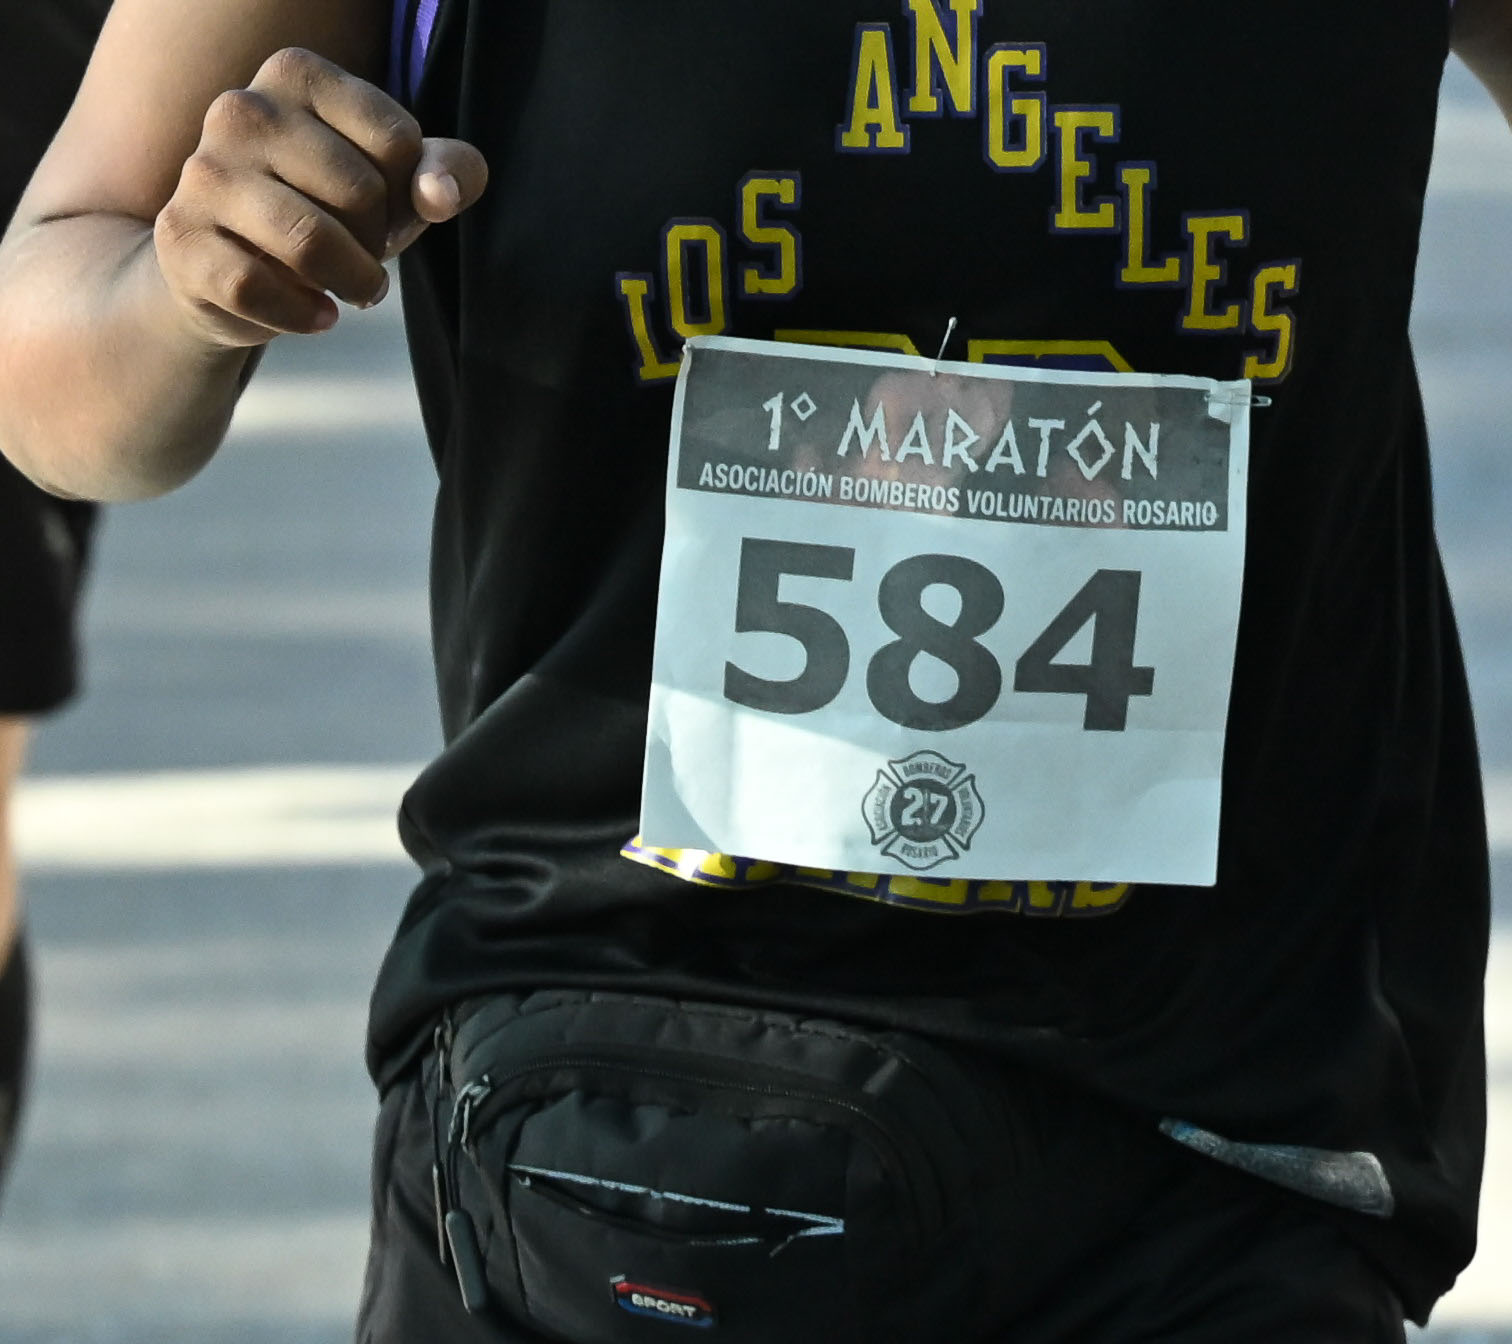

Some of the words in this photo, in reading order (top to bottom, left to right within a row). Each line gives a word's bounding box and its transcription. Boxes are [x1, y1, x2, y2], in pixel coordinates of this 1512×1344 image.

[614, 169, 806, 386] LOS
[836, 396, 1161, 482] MARATÓN
[698, 461, 834, 499] ASOCIACIÓN
[839, 475, 961, 513] BOMBEROS
[966, 488, 1116, 524] VOLUNTARIOS
[1122, 498, 1218, 527] ROSARIO
[723, 536, 1155, 732] 584
[900, 786, 949, 827] 27
